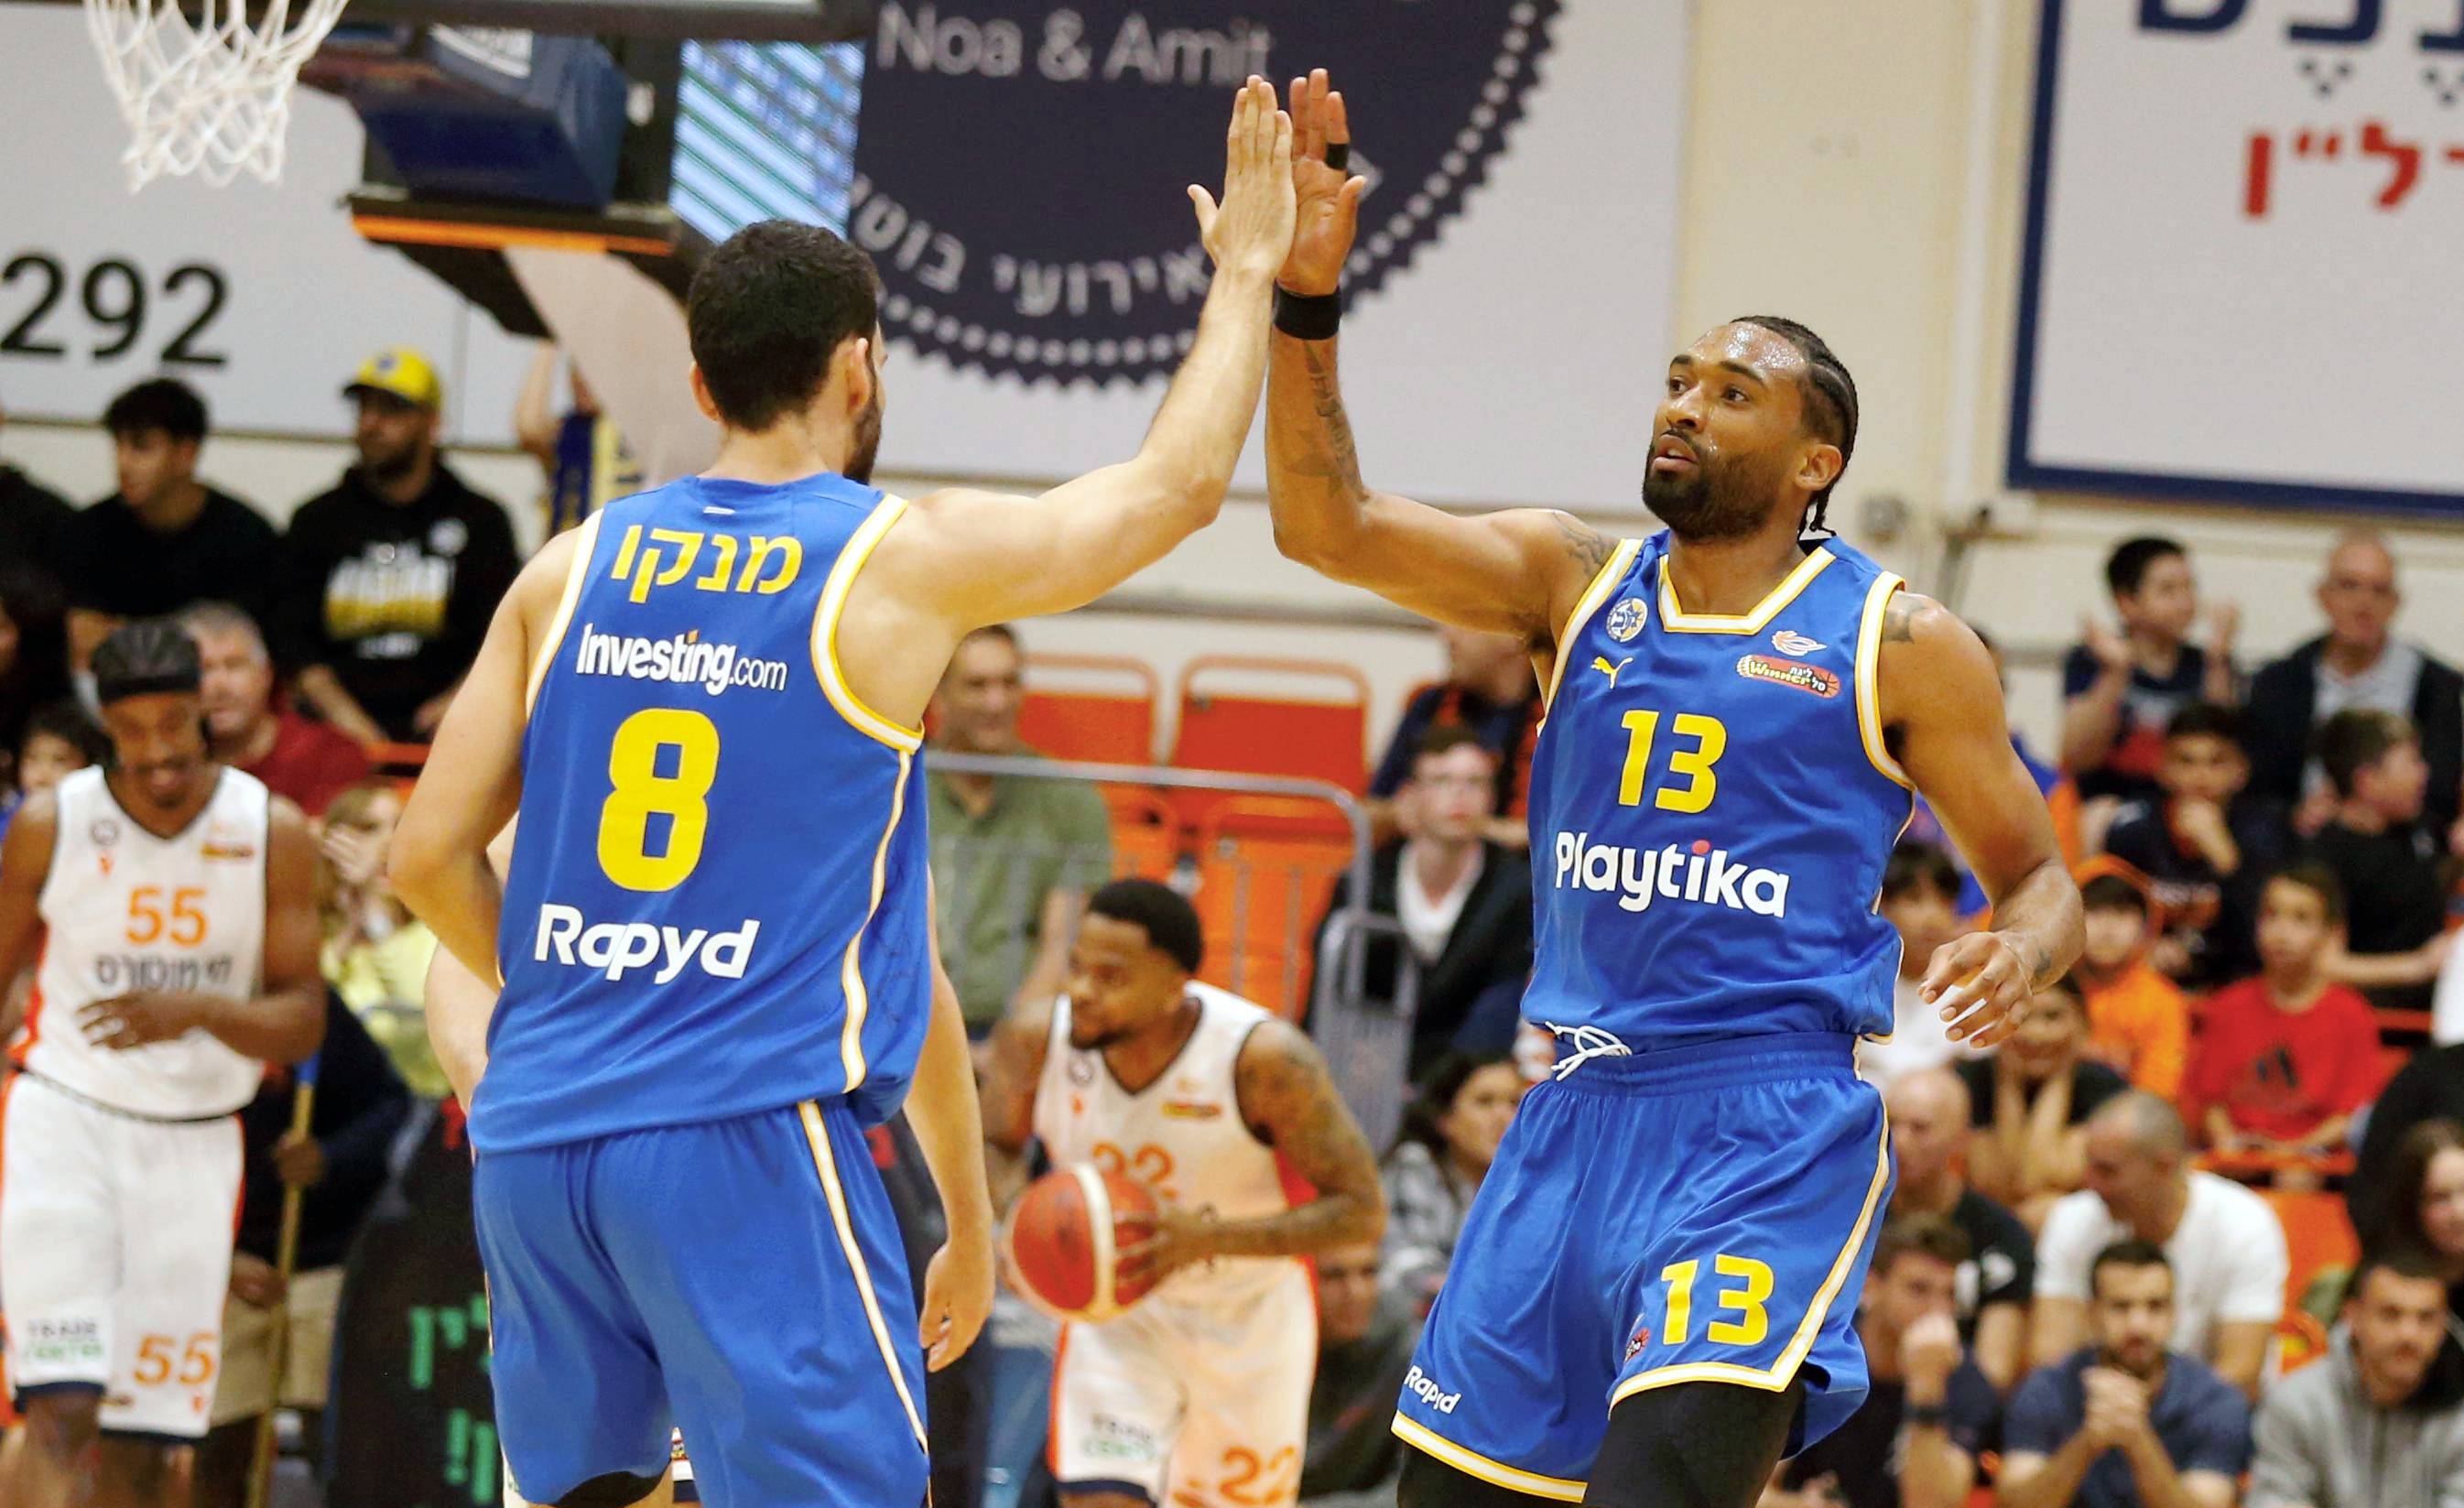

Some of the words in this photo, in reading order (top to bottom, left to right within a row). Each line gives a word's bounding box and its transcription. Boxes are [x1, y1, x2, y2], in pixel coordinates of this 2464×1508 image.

[876, 2, 1024, 77] Noa
[1037, 7, 1092, 81] &
[1103, 12, 1271, 85] Amit
[0, 254, 228, 366] 292
[611, 524, 803, 604] מנקו
[575, 622, 788, 697] Investing.com
[1749, 660, 1811, 686] Winner
[597, 708, 721, 893] 8
[1617, 709, 1728, 814] 13
[1555, 831, 1790, 918] Playtika
[126, 886, 208, 947] 55
[533, 903, 761, 985] Rapyd
[1661, 1253, 1775, 1346] 13
[134, 1331, 218, 1388] 55
